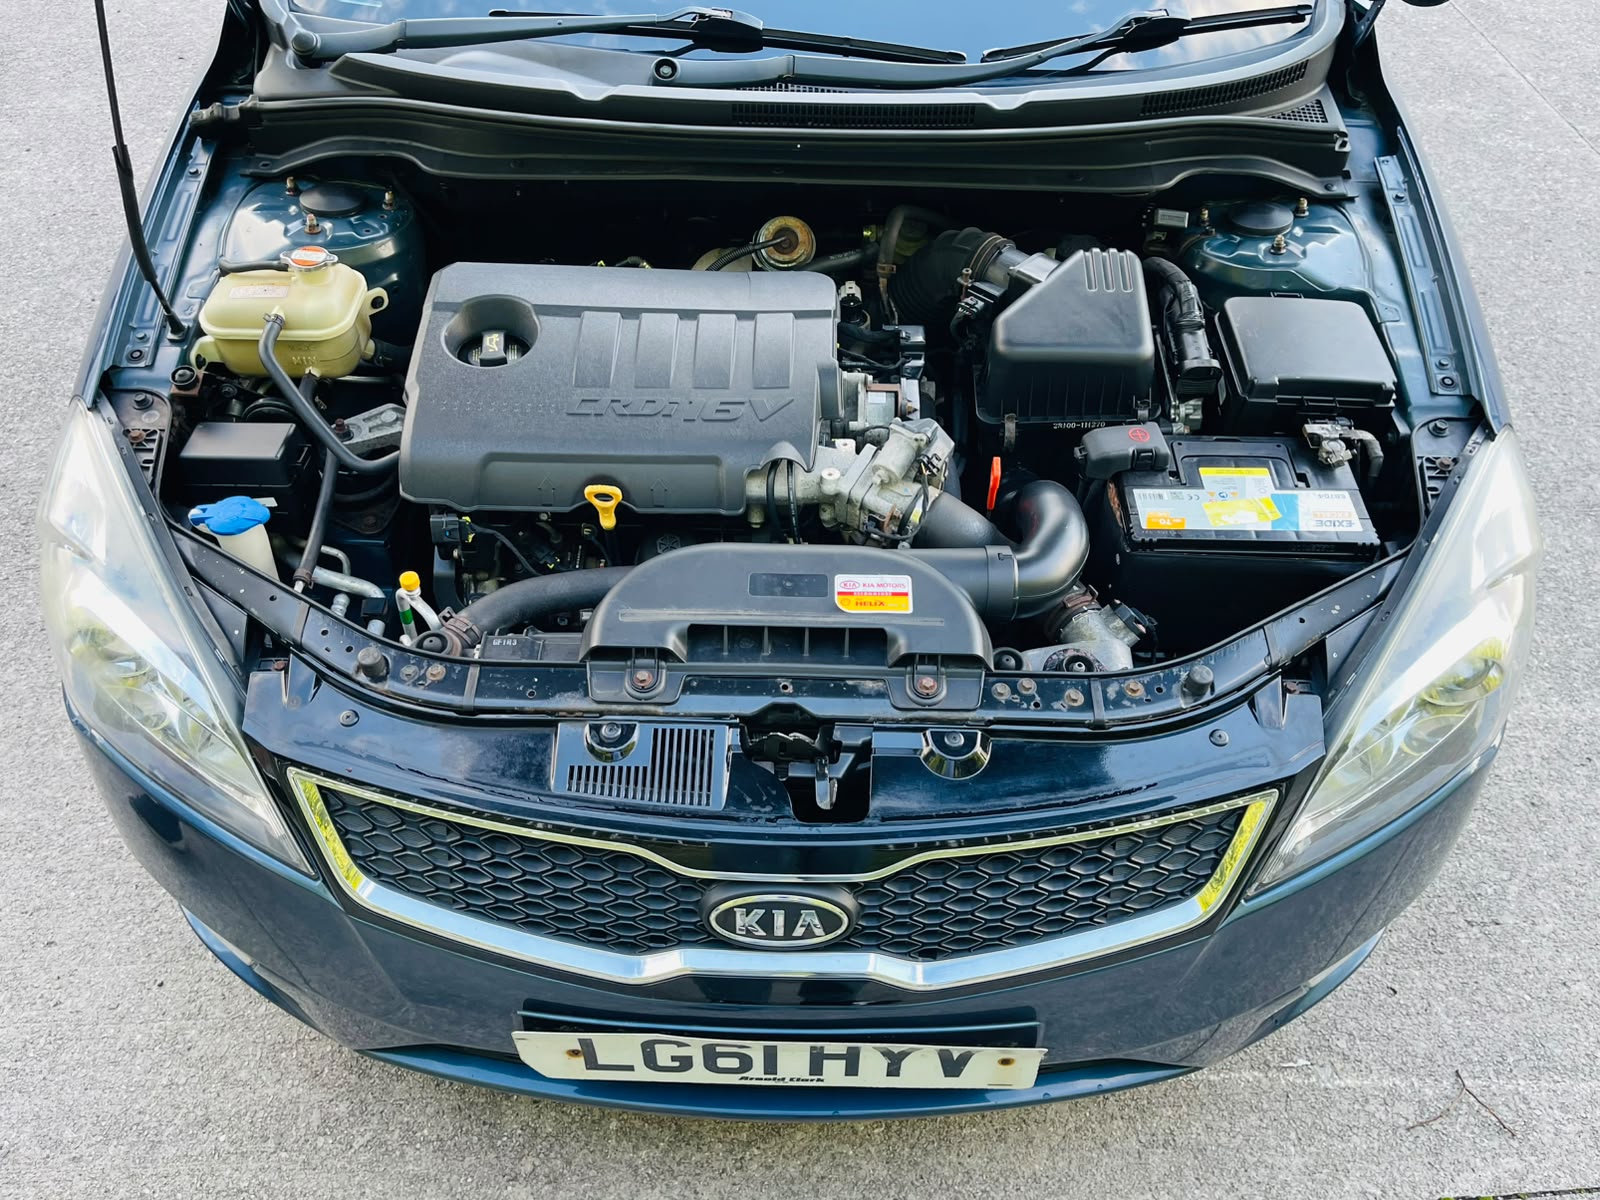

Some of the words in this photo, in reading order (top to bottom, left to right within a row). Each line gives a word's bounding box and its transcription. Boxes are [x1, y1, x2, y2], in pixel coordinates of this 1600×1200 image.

[1314, 519, 1352, 528] EXIDE
[733, 907, 826, 937] KIA
[577, 1038, 777, 1076] LG61
[808, 1045, 981, 1079] HYV
